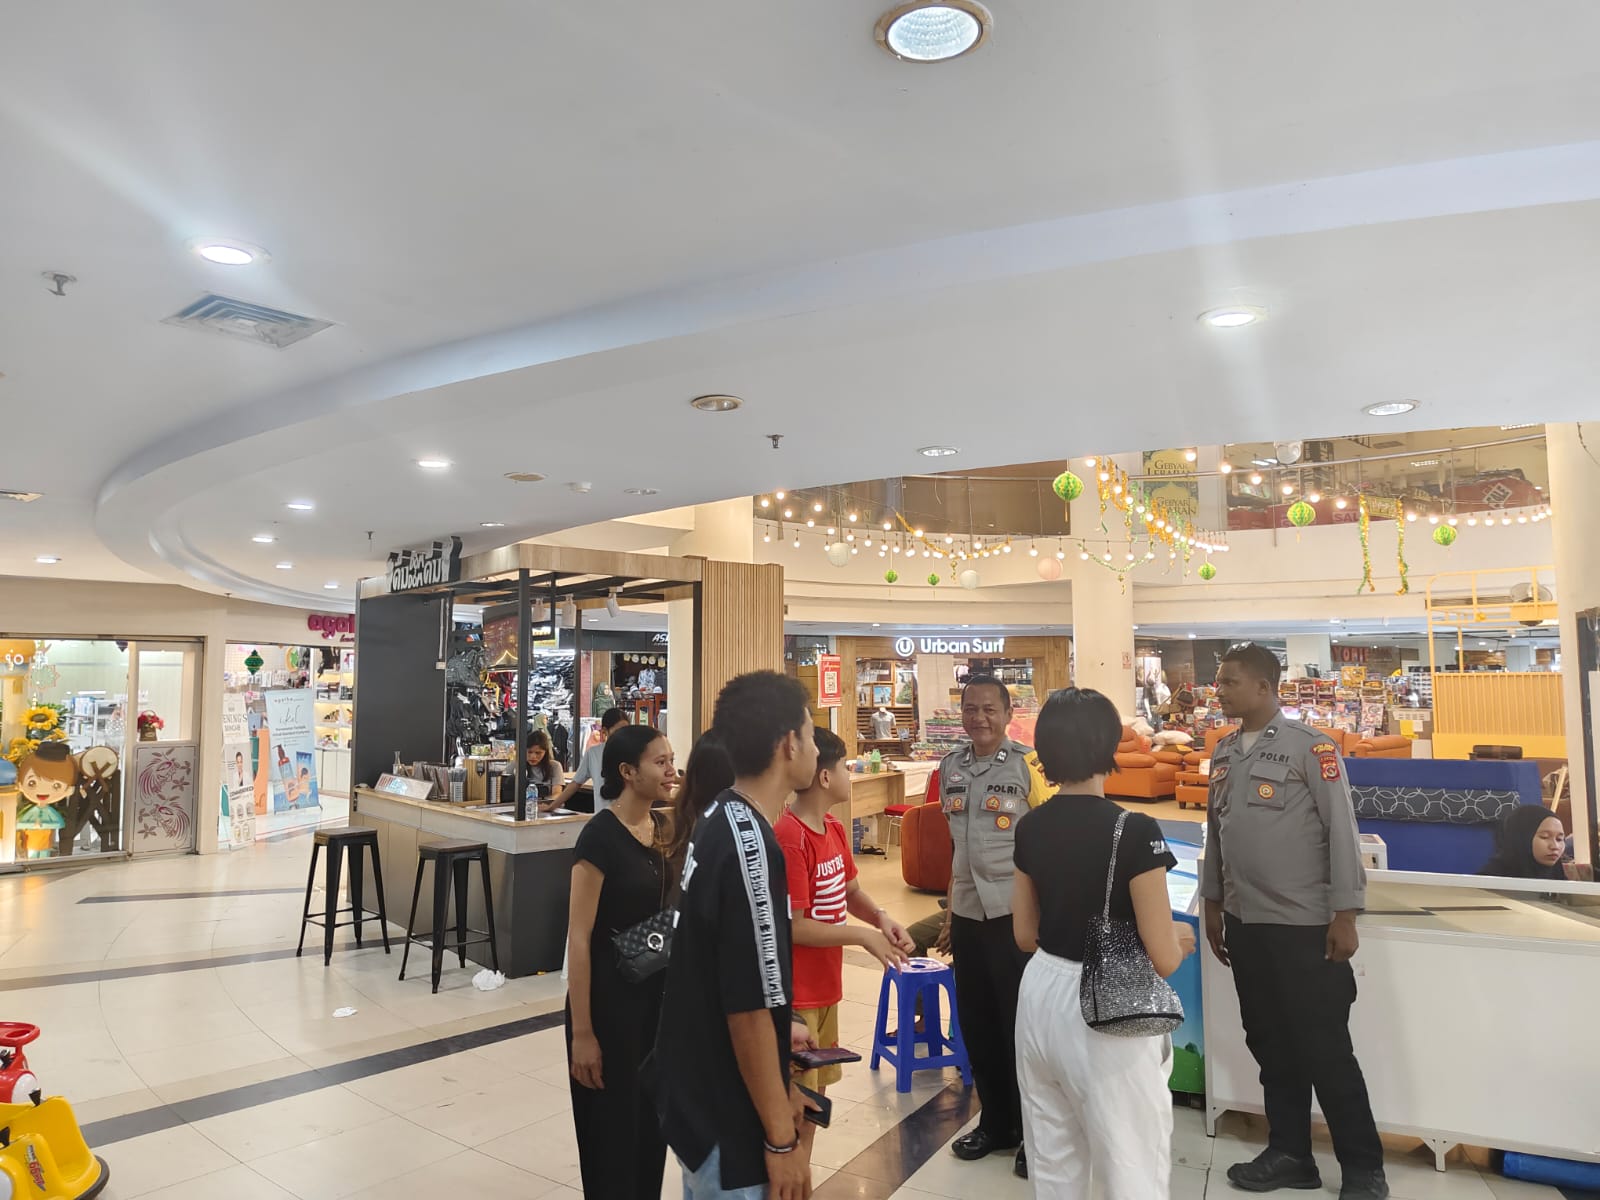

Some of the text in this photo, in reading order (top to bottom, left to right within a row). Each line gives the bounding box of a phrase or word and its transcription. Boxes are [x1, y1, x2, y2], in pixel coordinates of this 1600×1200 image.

[1147, 467, 1192, 477] LEBAR
[1334, 512, 1359, 522] SAL
[920, 638, 970, 653] Urban
[972, 638, 1005, 653] Surf
[1260, 751, 1290, 764] POLRI
[986, 784, 1018, 796] POLRI
[740, 829, 758, 852] CLUB
[745, 852, 767, 903] BASEBALL
